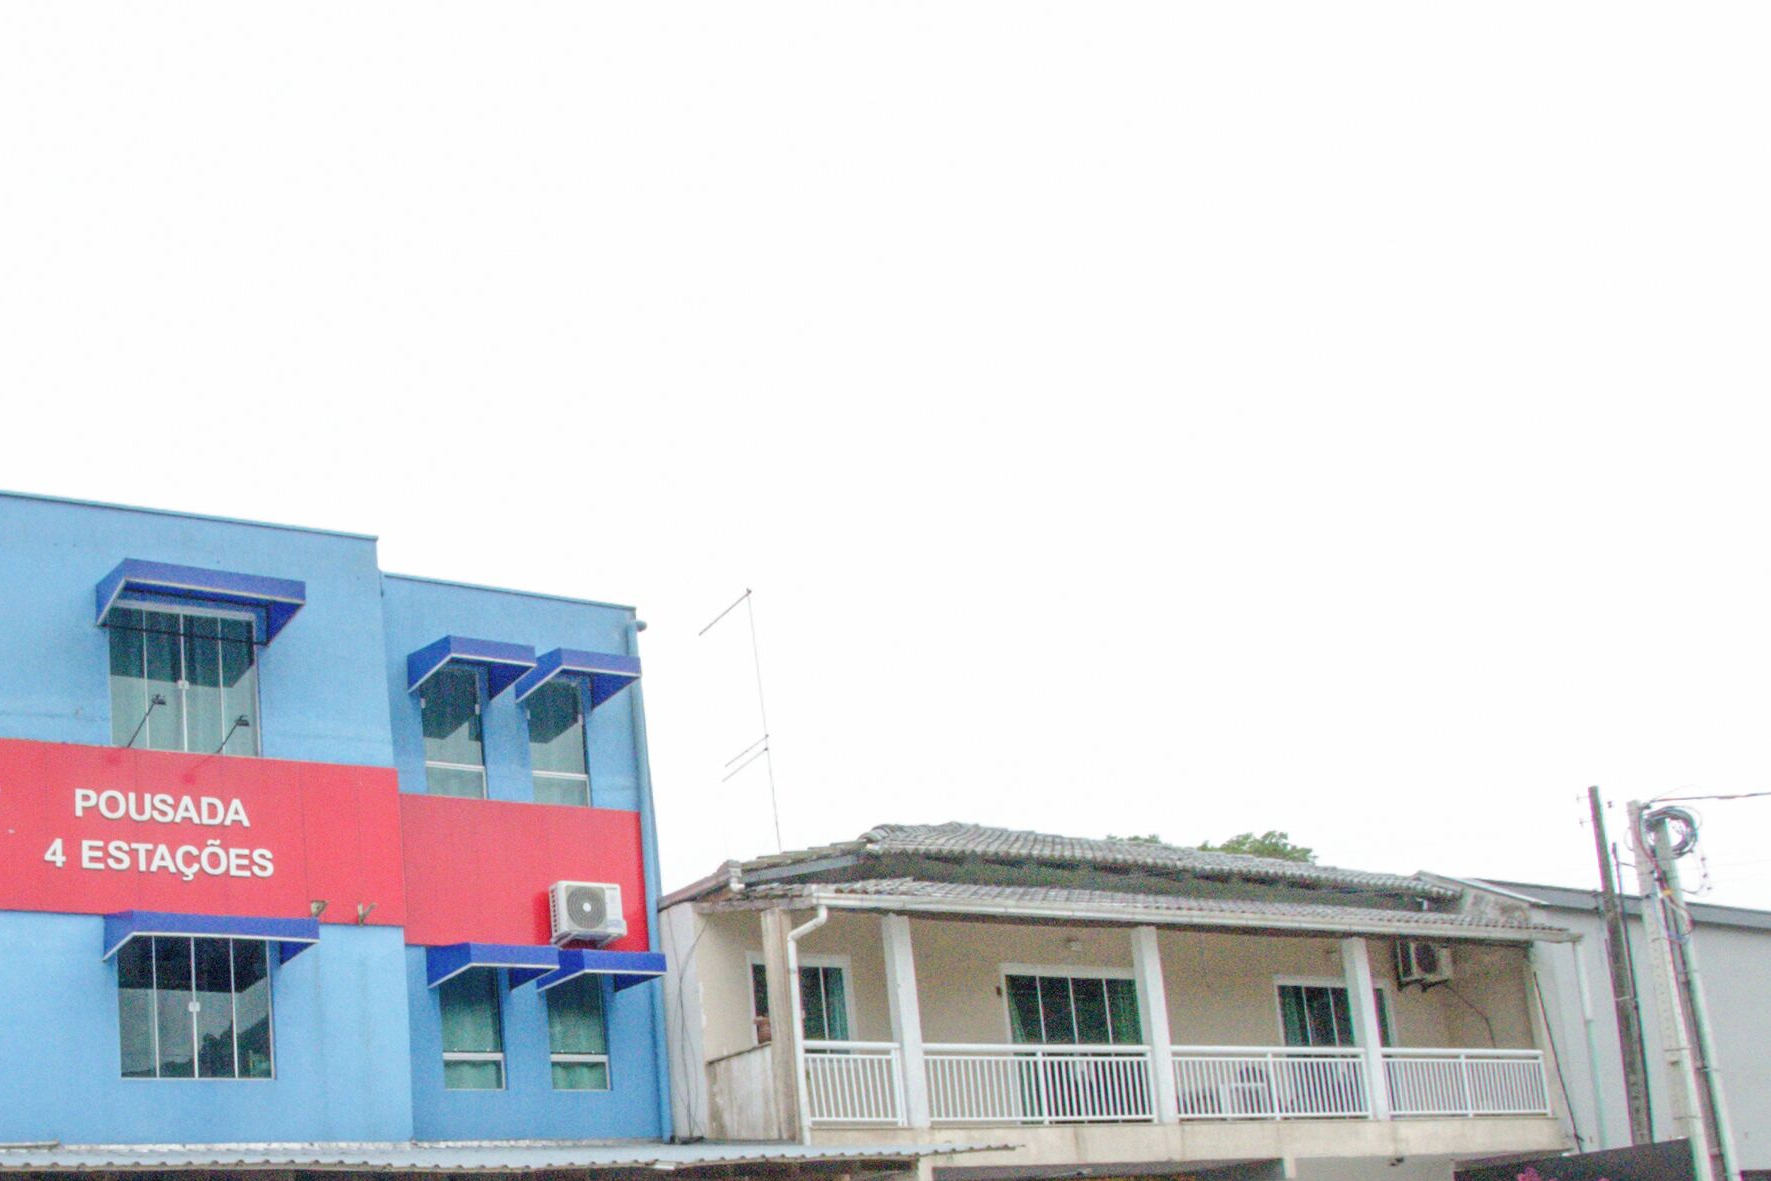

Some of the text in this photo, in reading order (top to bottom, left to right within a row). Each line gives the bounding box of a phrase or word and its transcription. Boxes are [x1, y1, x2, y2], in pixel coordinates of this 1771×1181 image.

[74, 788, 250, 828] POUSADA
[44, 838, 275, 881] 4 ESTAÇÕES
